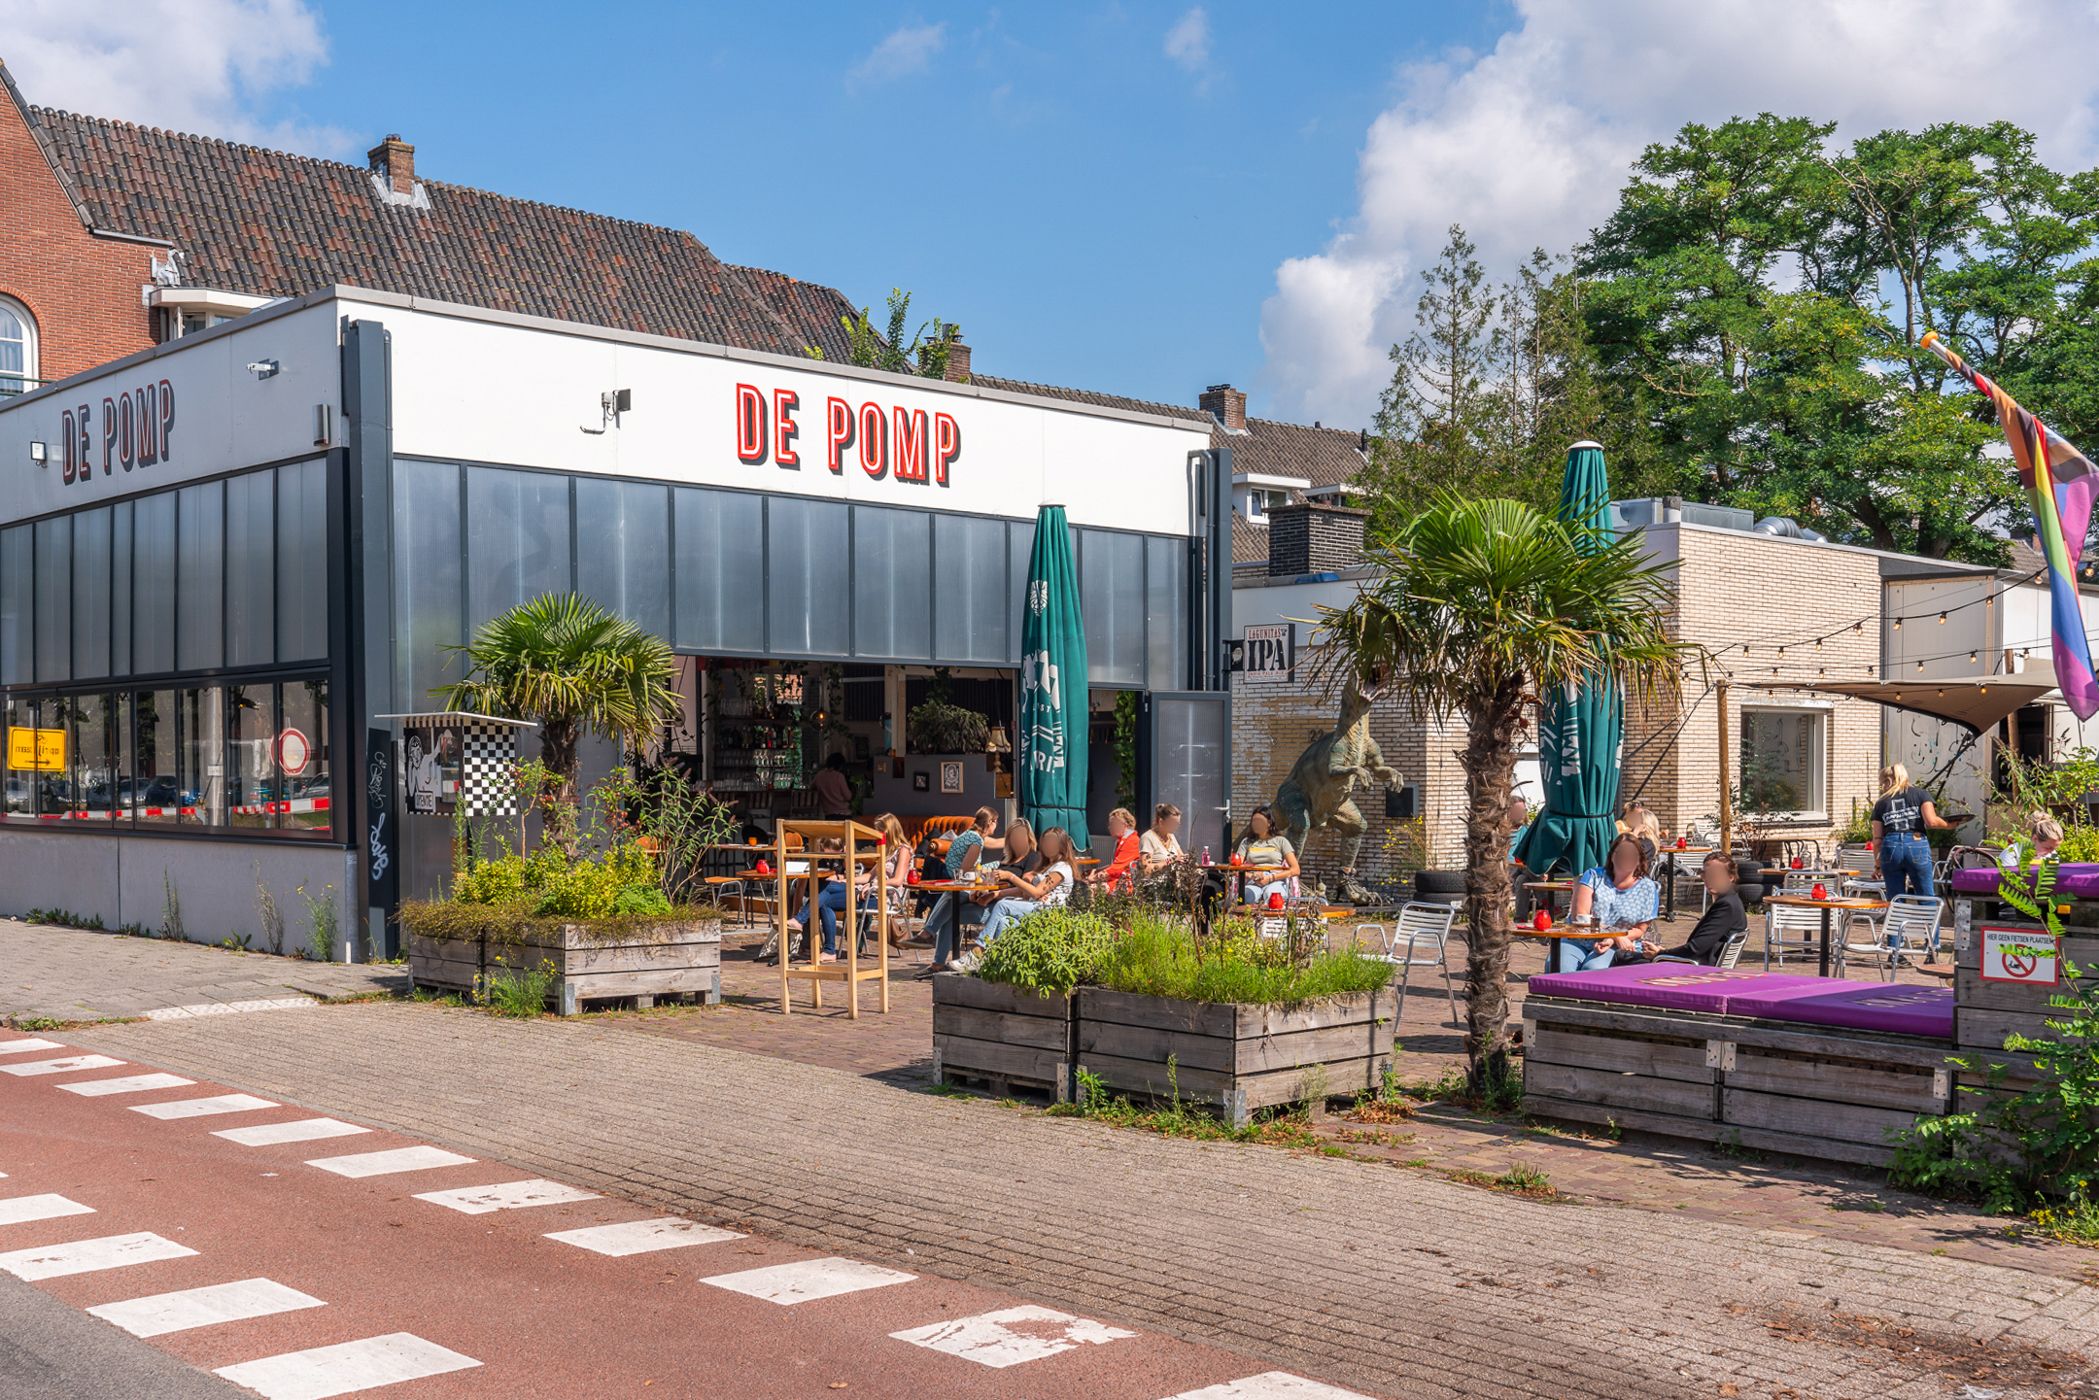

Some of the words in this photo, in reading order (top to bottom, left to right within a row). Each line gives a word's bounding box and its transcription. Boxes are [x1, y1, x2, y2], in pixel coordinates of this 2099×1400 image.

[62, 404, 91, 486] DE
[102, 379, 176, 476] POMP
[736, 383, 801, 471] DE
[827, 396, 961, 488] POMP
[1247, 638, 1286, 672] IPA
[1987, 933, 1998, 941] HIER
